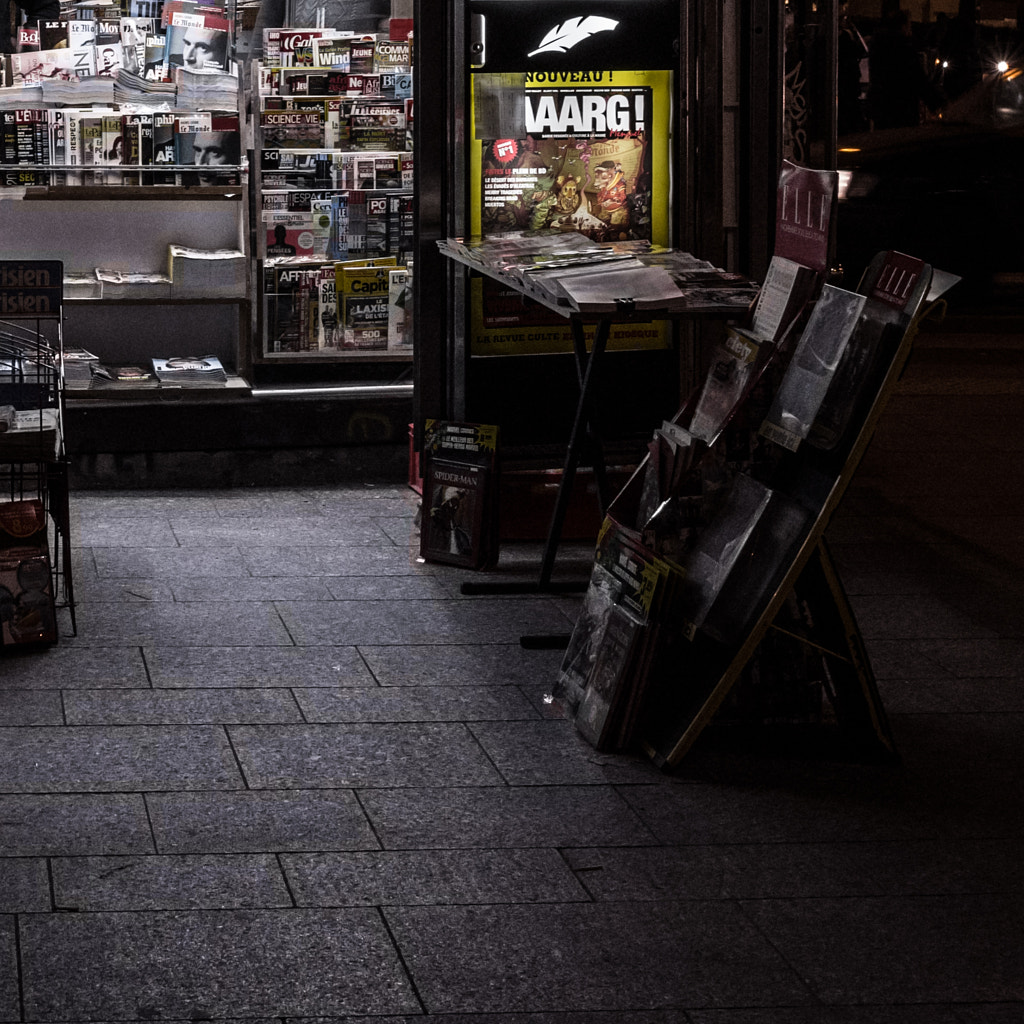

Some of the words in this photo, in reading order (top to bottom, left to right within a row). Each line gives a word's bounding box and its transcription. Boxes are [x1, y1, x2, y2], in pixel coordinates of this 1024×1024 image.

[319, 52, 350, 66] Wind
[267, 113, 302, 125] SCIENCE
[304, 113, 319, 124] VIE
[69, 116, 77, 152] RESPECT
[781, 184, 826, 233] ELLE
[875, 263, 917, 300] ELLE
[493, 335, 527, 343] REVUE
[527, 333, 561, 341] CULTE
[434, 471, 478, 487] SPIDER-MAN
